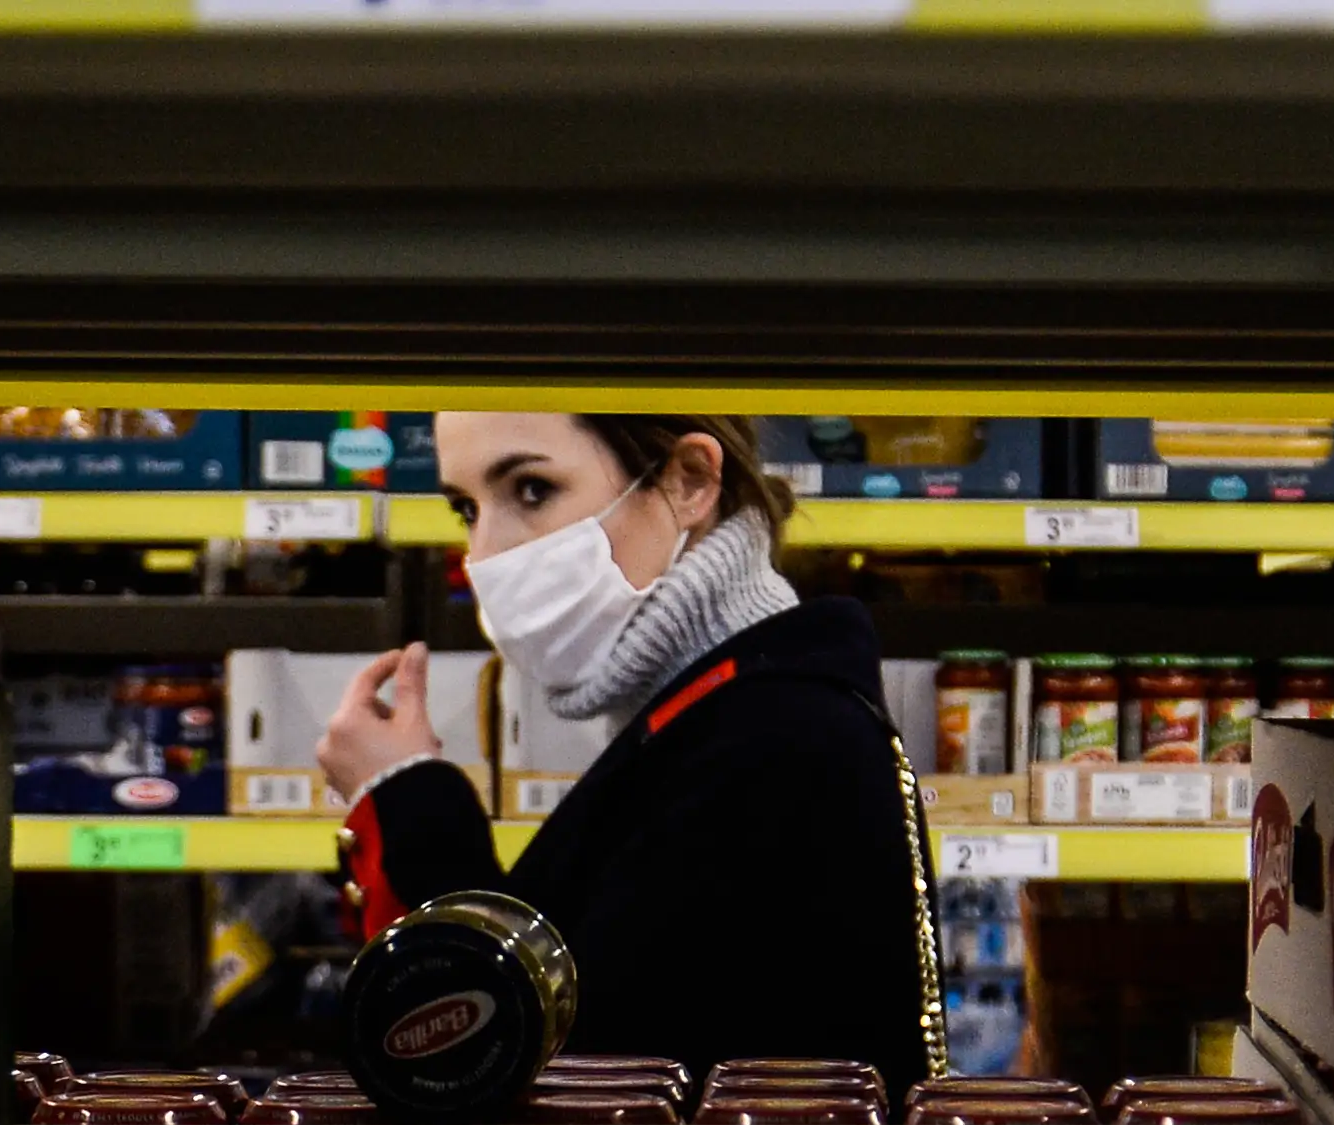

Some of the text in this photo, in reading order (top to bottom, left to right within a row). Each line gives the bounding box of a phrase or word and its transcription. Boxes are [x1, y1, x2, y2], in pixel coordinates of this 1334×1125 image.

[1046, 516, 1060, 540] 3
[958, 845, 972, 870] 2
[394, 1004, 470, 1051] Barilla
